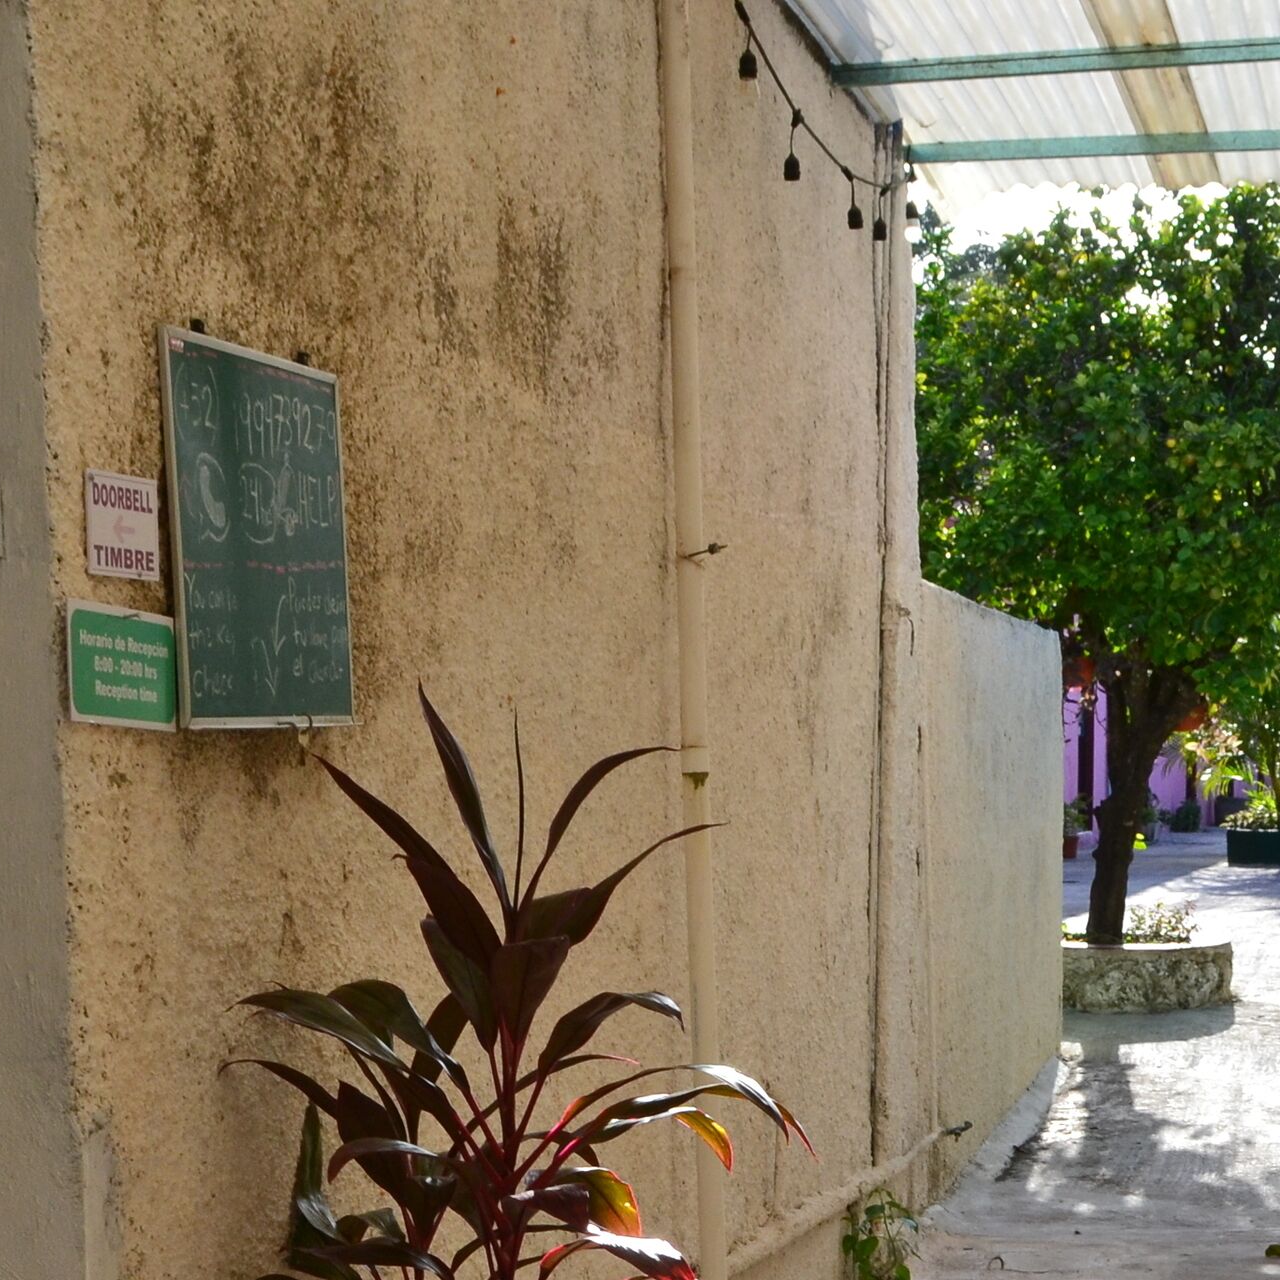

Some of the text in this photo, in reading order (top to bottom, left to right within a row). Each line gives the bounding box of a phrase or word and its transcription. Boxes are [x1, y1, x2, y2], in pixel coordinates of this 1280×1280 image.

[92, 481, 154, 515] DOORBELL
[93, 543, 156, 573] TIMBRE
[79, 628, 169, 659] Horario de Recepción
[144, 662, 158, 681] hrs
[95, 678, 158, 704] Reception time
